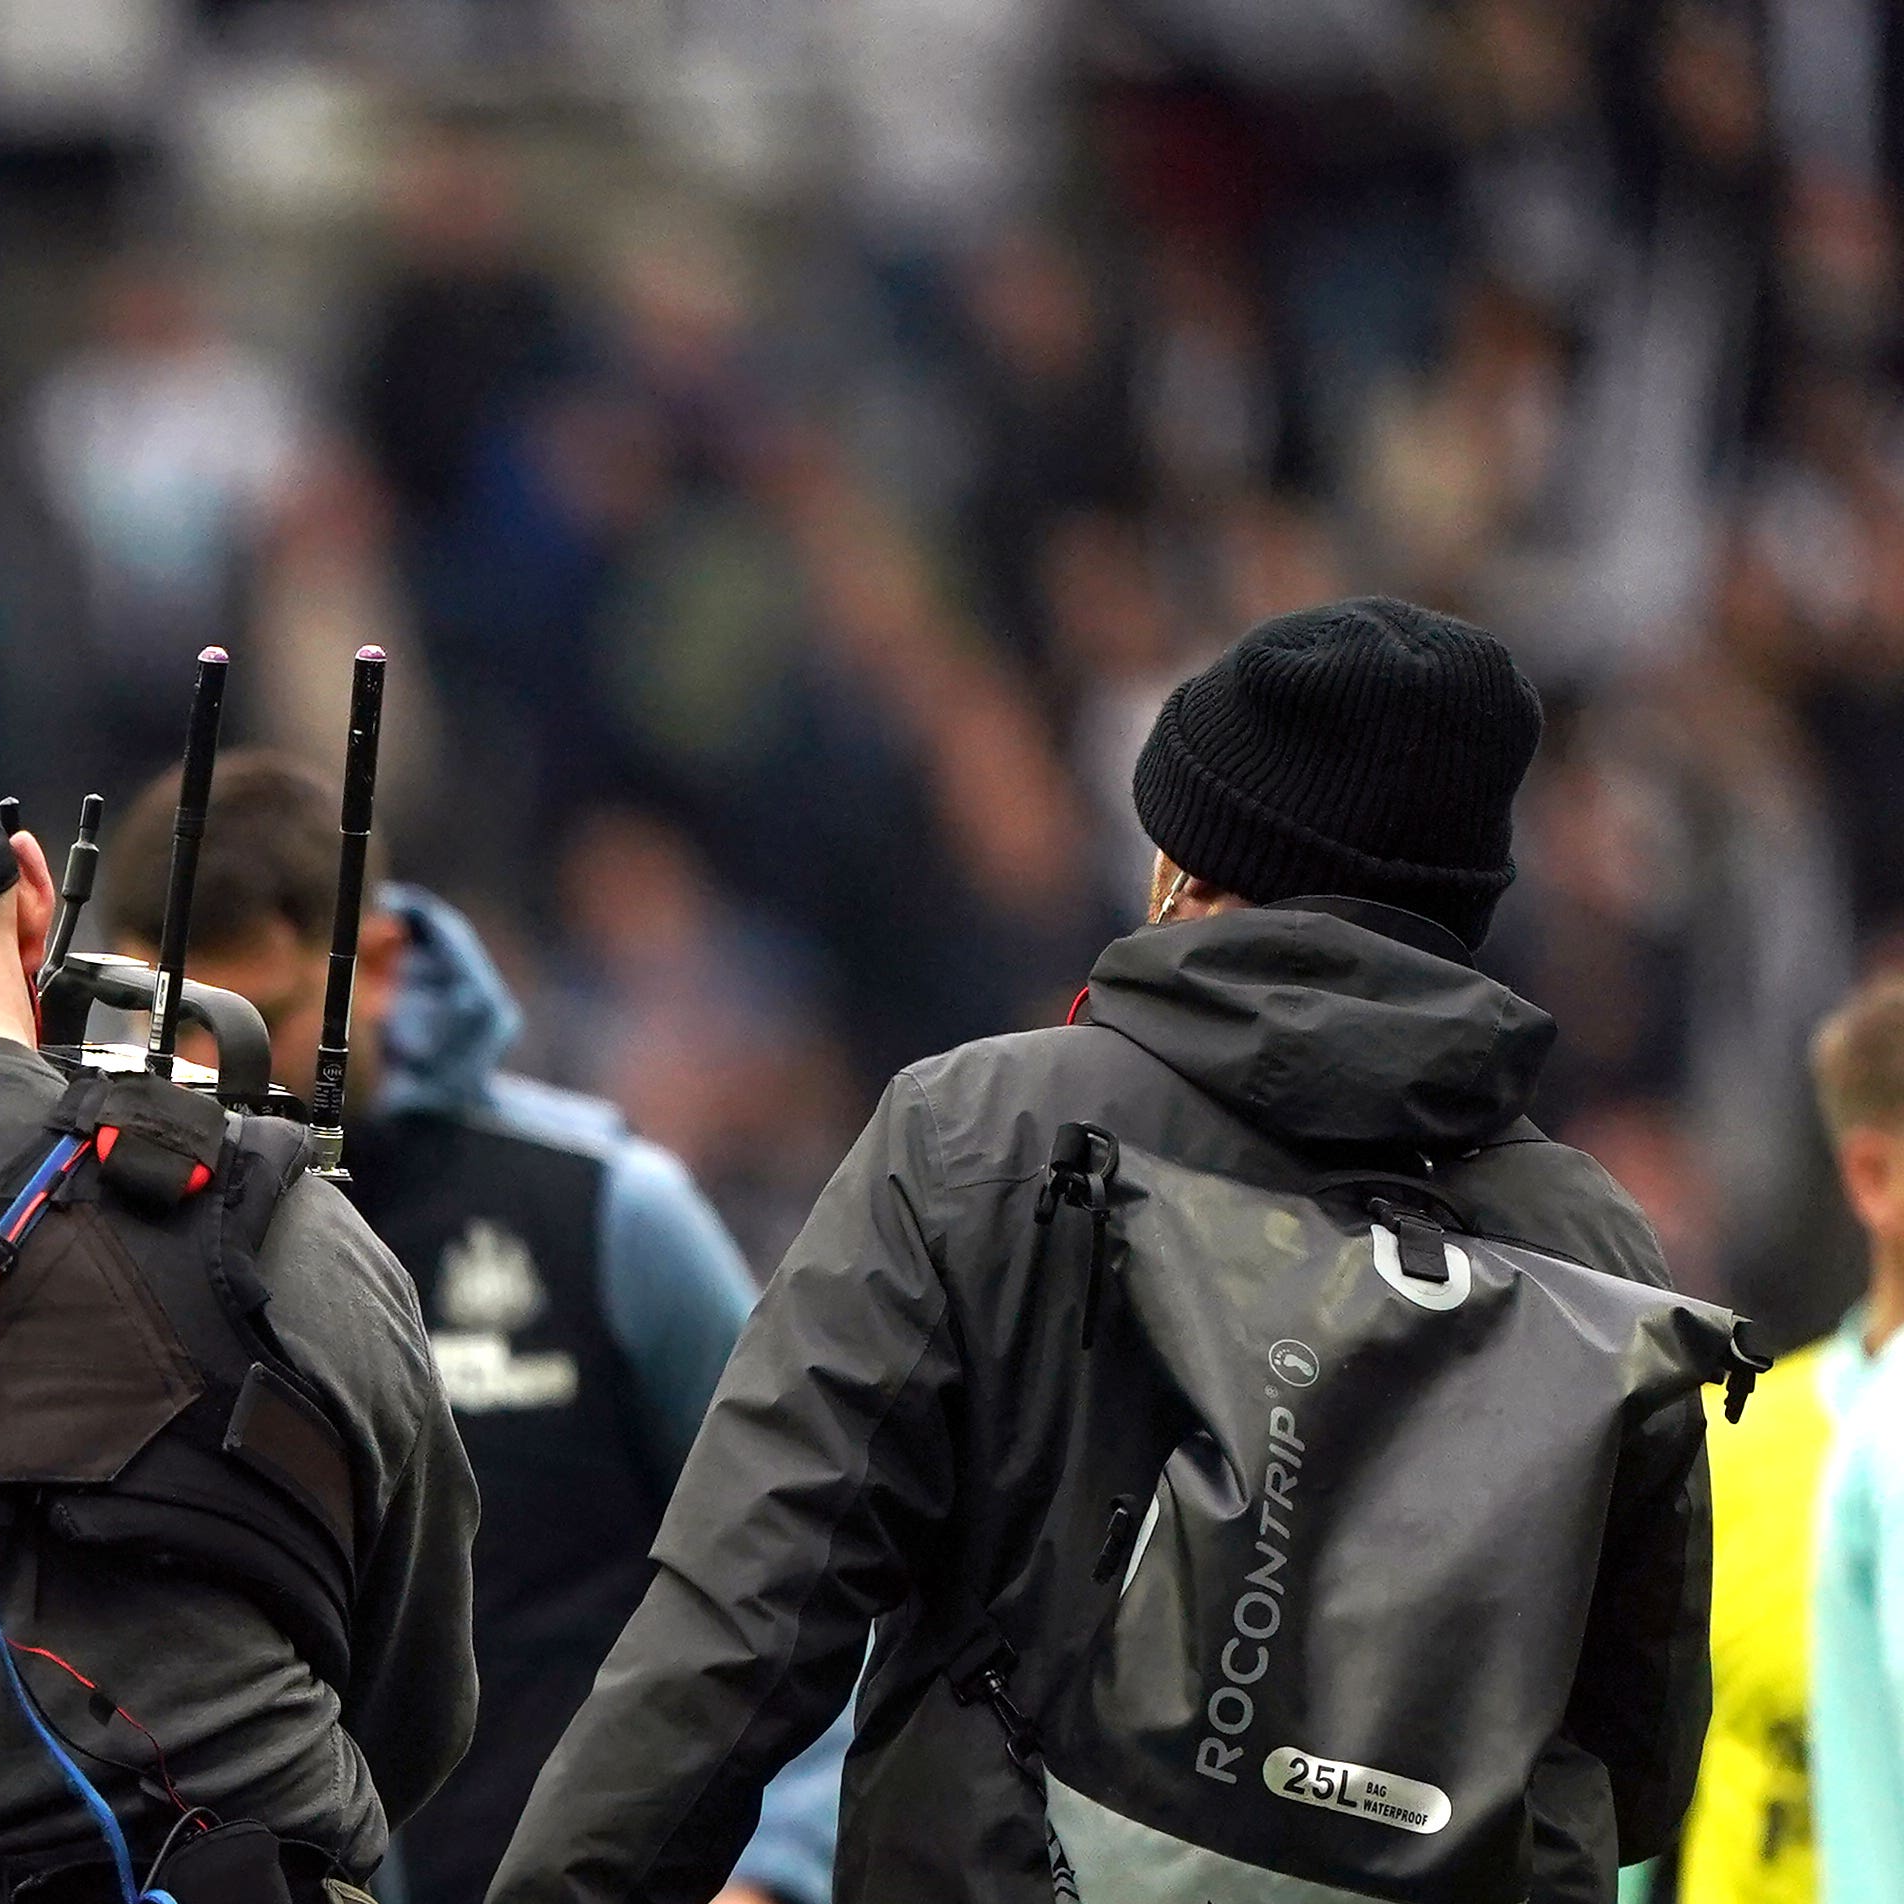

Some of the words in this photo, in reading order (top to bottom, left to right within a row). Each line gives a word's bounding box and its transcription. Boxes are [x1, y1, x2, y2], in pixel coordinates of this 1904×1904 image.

[1195, 1406, 1306, 1784] ROCONTRIP
[1283, 1757, 1358, 1808] 25L
[1366, 1782, 1387, 1798] BAG
[1363, 1799, 1429, 1827] WATERPROOF
